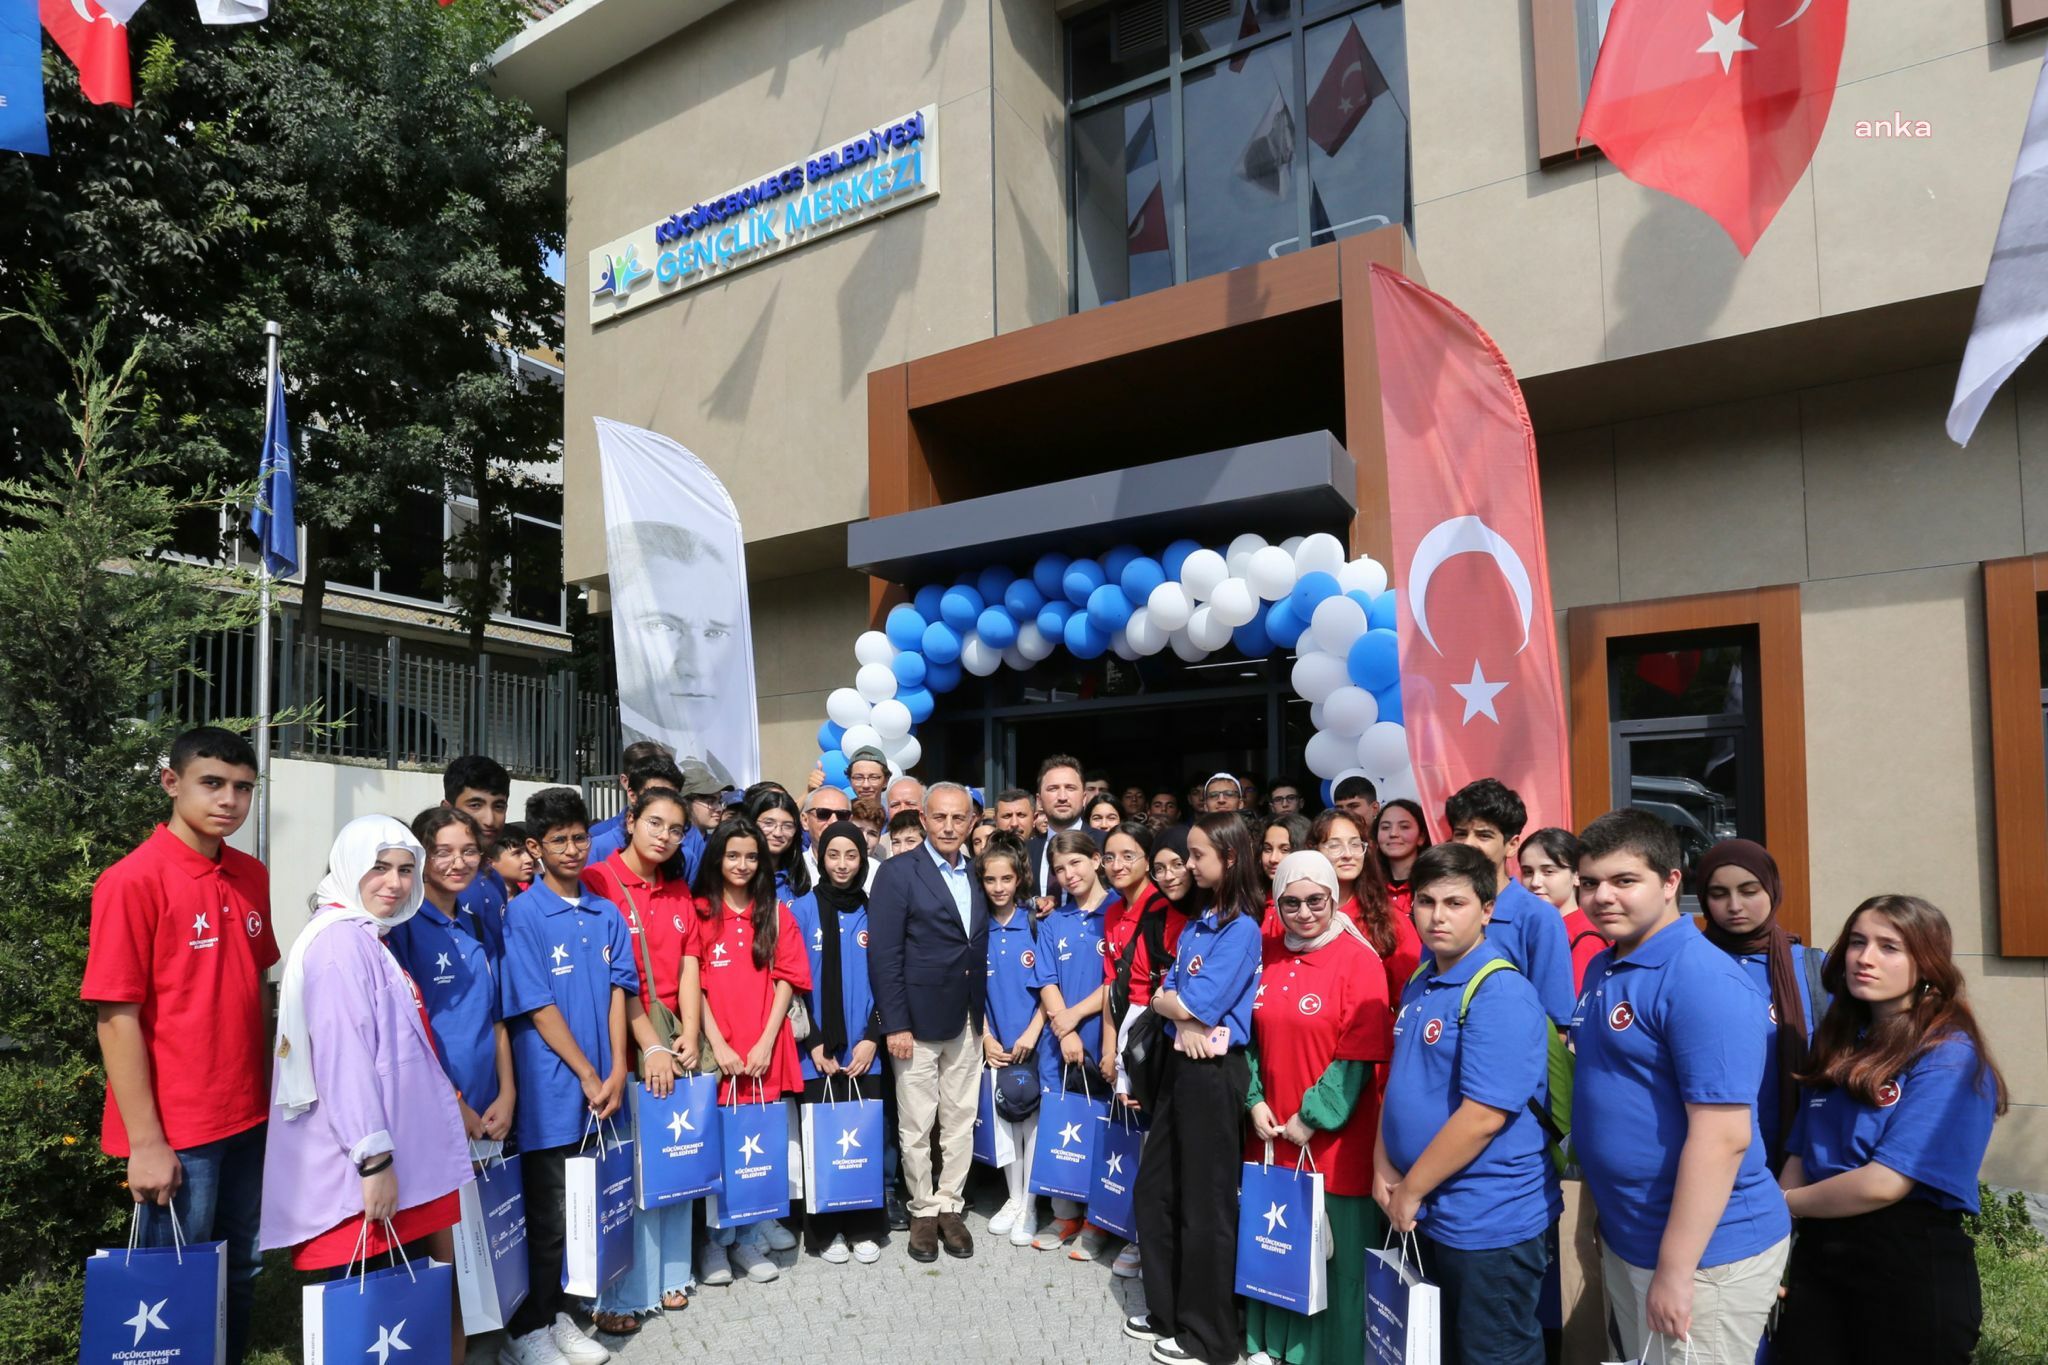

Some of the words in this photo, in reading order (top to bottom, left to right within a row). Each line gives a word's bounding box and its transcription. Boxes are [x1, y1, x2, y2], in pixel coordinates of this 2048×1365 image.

[655, 165, 804, 245] KÜÇÜKÇEKMECE
[806, 110, 925, 183] BELEDİYESİ
[656, 207, 778, 284] GENÇLİK
[785, 140, 925, 236] MERKEZİ
[112, 1349, 181, 1360] KÜÇÜKÇEKMECE
